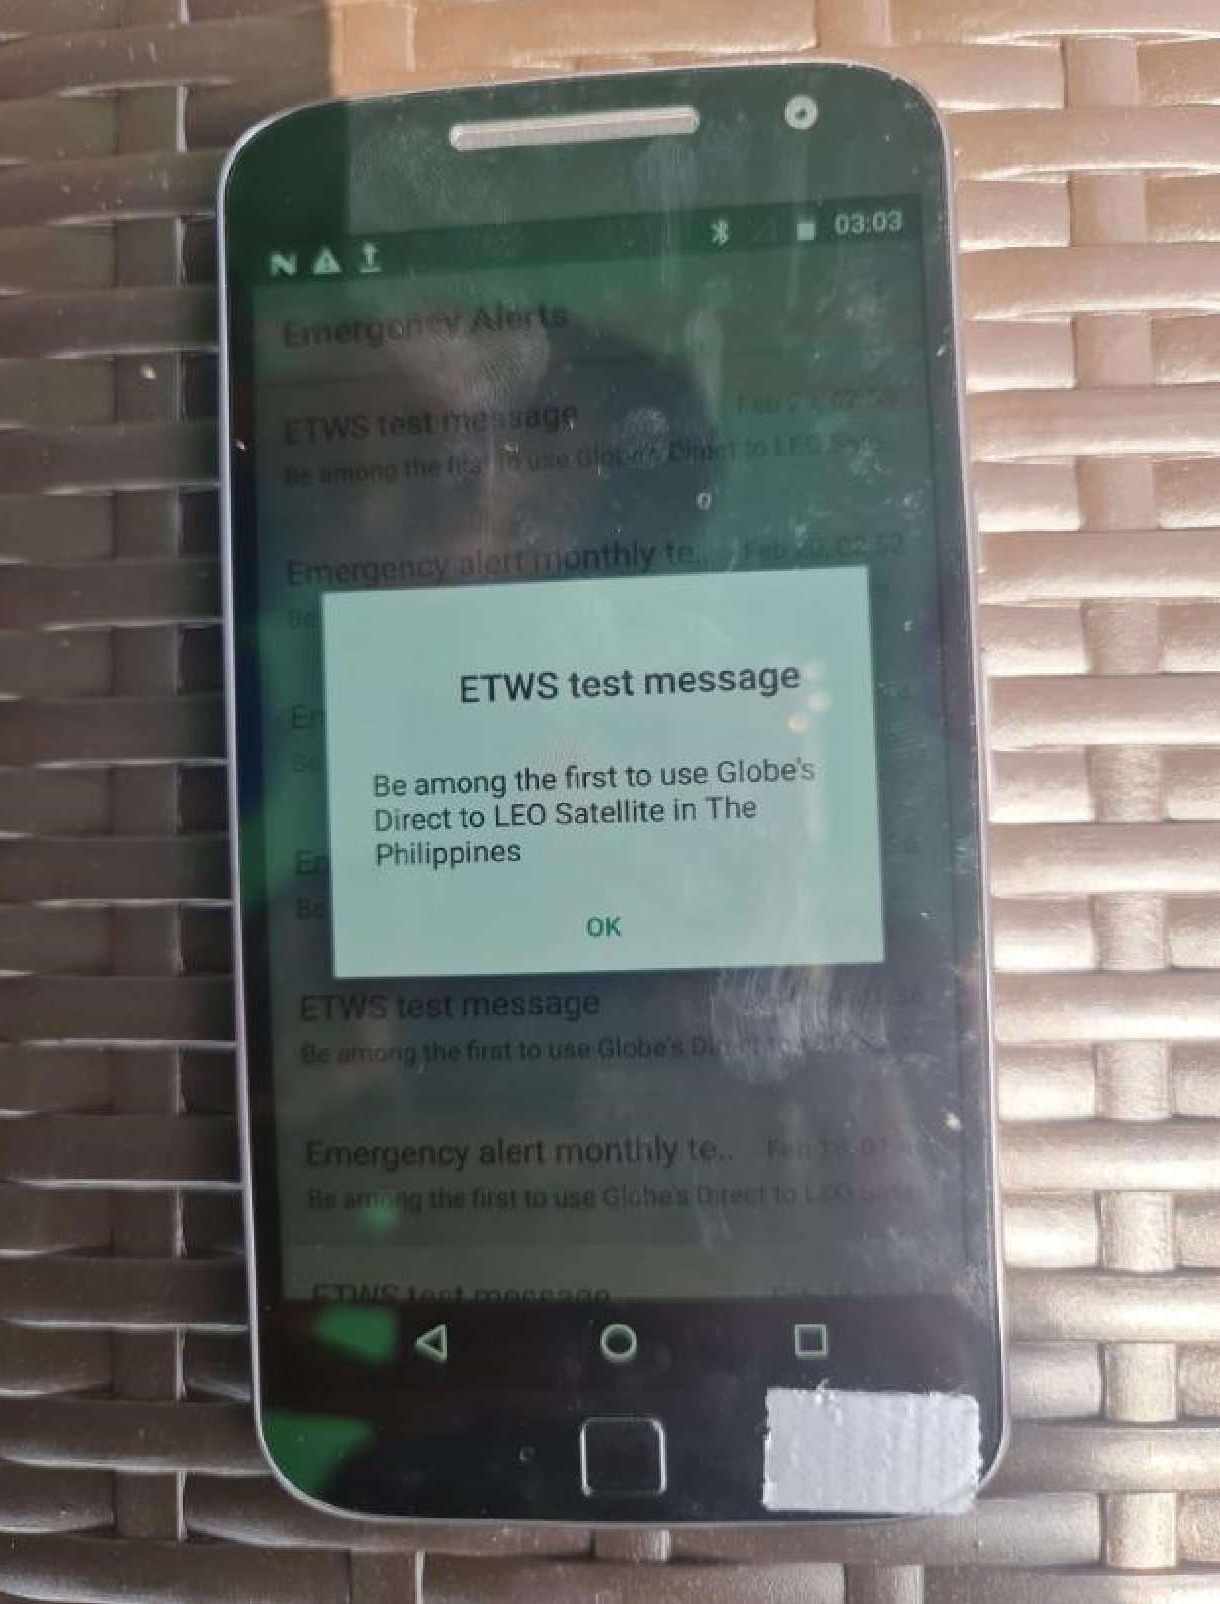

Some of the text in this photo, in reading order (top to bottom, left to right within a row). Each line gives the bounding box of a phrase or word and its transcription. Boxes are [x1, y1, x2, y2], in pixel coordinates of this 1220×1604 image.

[835, 209, 903, 235] 03:03
[472, 301, 570, 333] Alerts
[283, 402, 579, 444] ETWS test message
[283, 464, 314, 486] Be
[319, 461, 398, 485] among
[403, 455, 441, 479] the
[287, 554, 451, 587] Emergency
[459, 550, 523, 579] alert
[530, 540, 654, 574] monthly
[459, 665, 802, 703] ETWS test message
[373, 757, 816, 800] Be among the first to use Globe's
[374, 795, 758, 832] Direct to LEO Satellite in The
[376, 840, 522, 871] Philippines
[586, 916, 623, 939] OK
[299, 993, 601, 1022] ETWS test message
[300, 1041, 332, 1065] Be
[337, 1044, 418, 1070] among
[423, 1039, 462, 1063] the
[467, 1038, 513, 1063] first
[519, 1040, 542, 1062] to
[548, 1042, 592, 1061] use
[597, 1034, 686, 1060] Globe's
[306, 1140, 470, 1172] Emergency
[479, 1136, 547, 1167] alert
[555, 1133, 679, 1168] monthly
[307, 1188, 338, 1210] Be
[429, 1184, 466, 1209] the
[471, 1183, 518, 1209] first
[524, 1185, 548, 1208] to
[554, 1187, 597, 1208] use
[602, 1182, 689, 1208] Globe's
[696, 1182, 764, 1206] Direct
[773, 1184, 797, 1205] to
[805, 1182, 854, 1203] LEO
